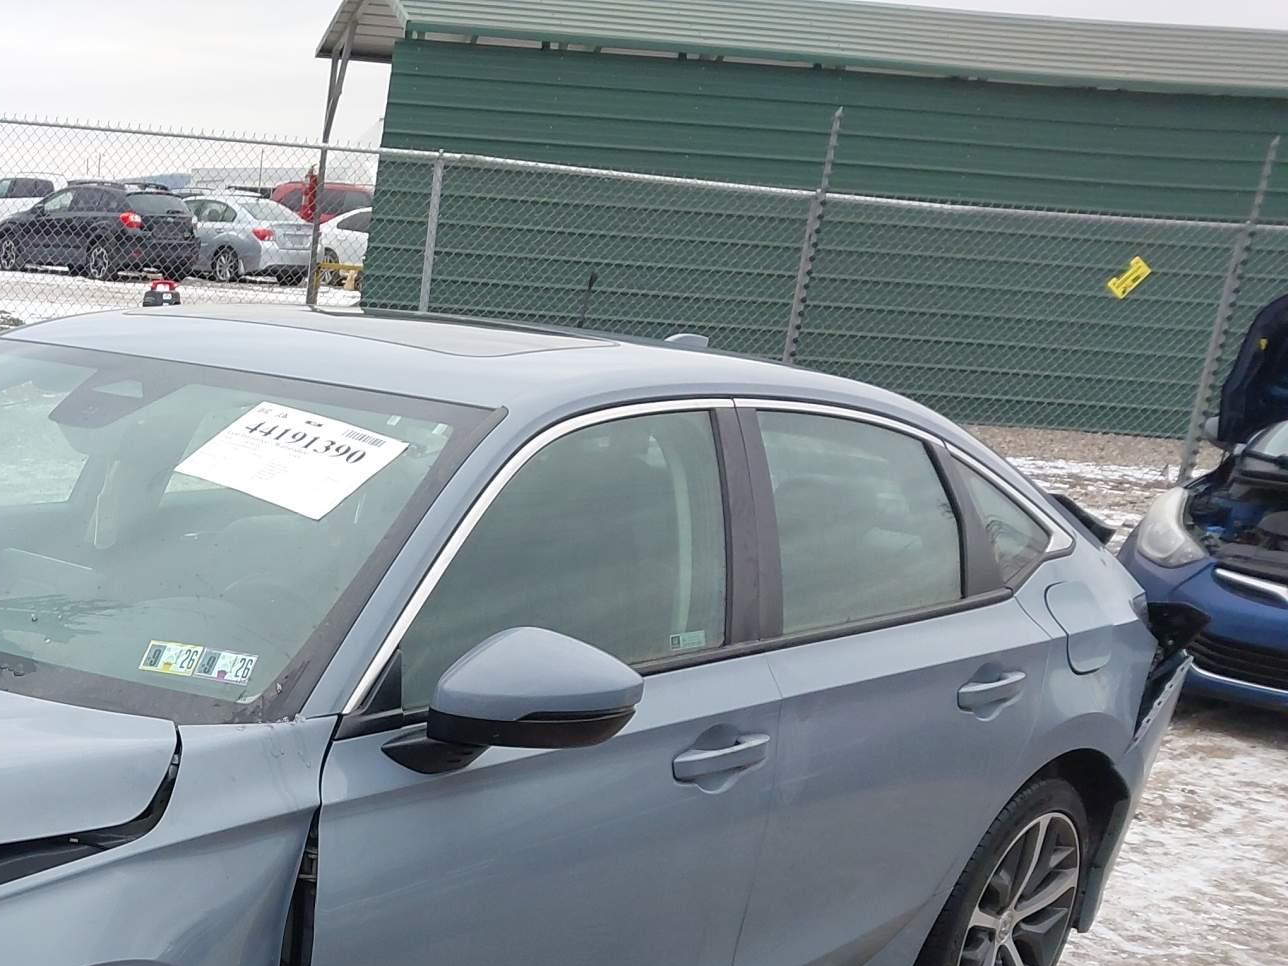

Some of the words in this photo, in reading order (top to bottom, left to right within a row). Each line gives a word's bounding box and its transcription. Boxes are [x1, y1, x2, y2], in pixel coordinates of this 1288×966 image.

[245, 420, 368, 464] 44191390
[179, 649, 199, 669] 26
[234, 657, 254, 679] 26
